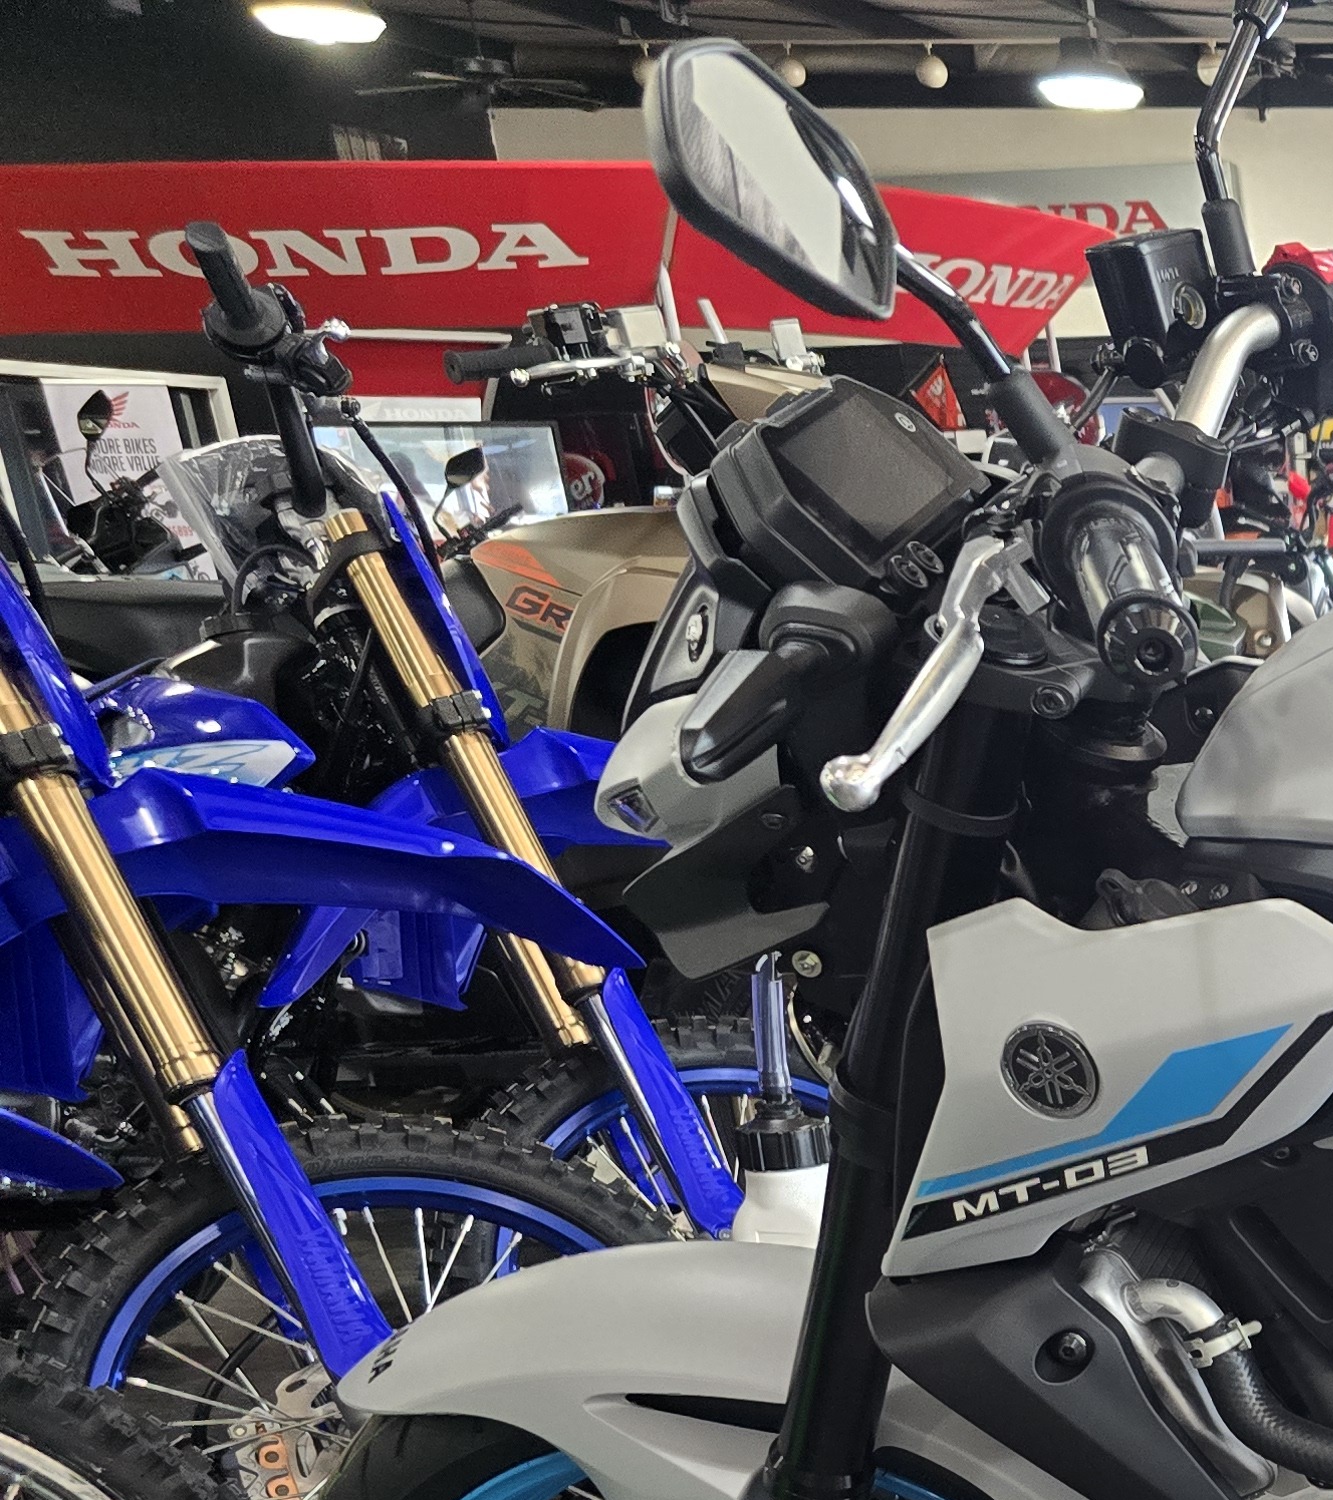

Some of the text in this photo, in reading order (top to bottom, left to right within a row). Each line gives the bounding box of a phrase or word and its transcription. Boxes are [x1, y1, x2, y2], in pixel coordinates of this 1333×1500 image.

[19, 222, 590, 278] HONDA
[383, 407, 471, 421] HONDA
[123, 437, 157, 455] BIKES
[952, 1145, 1149, 1222] MT-03
